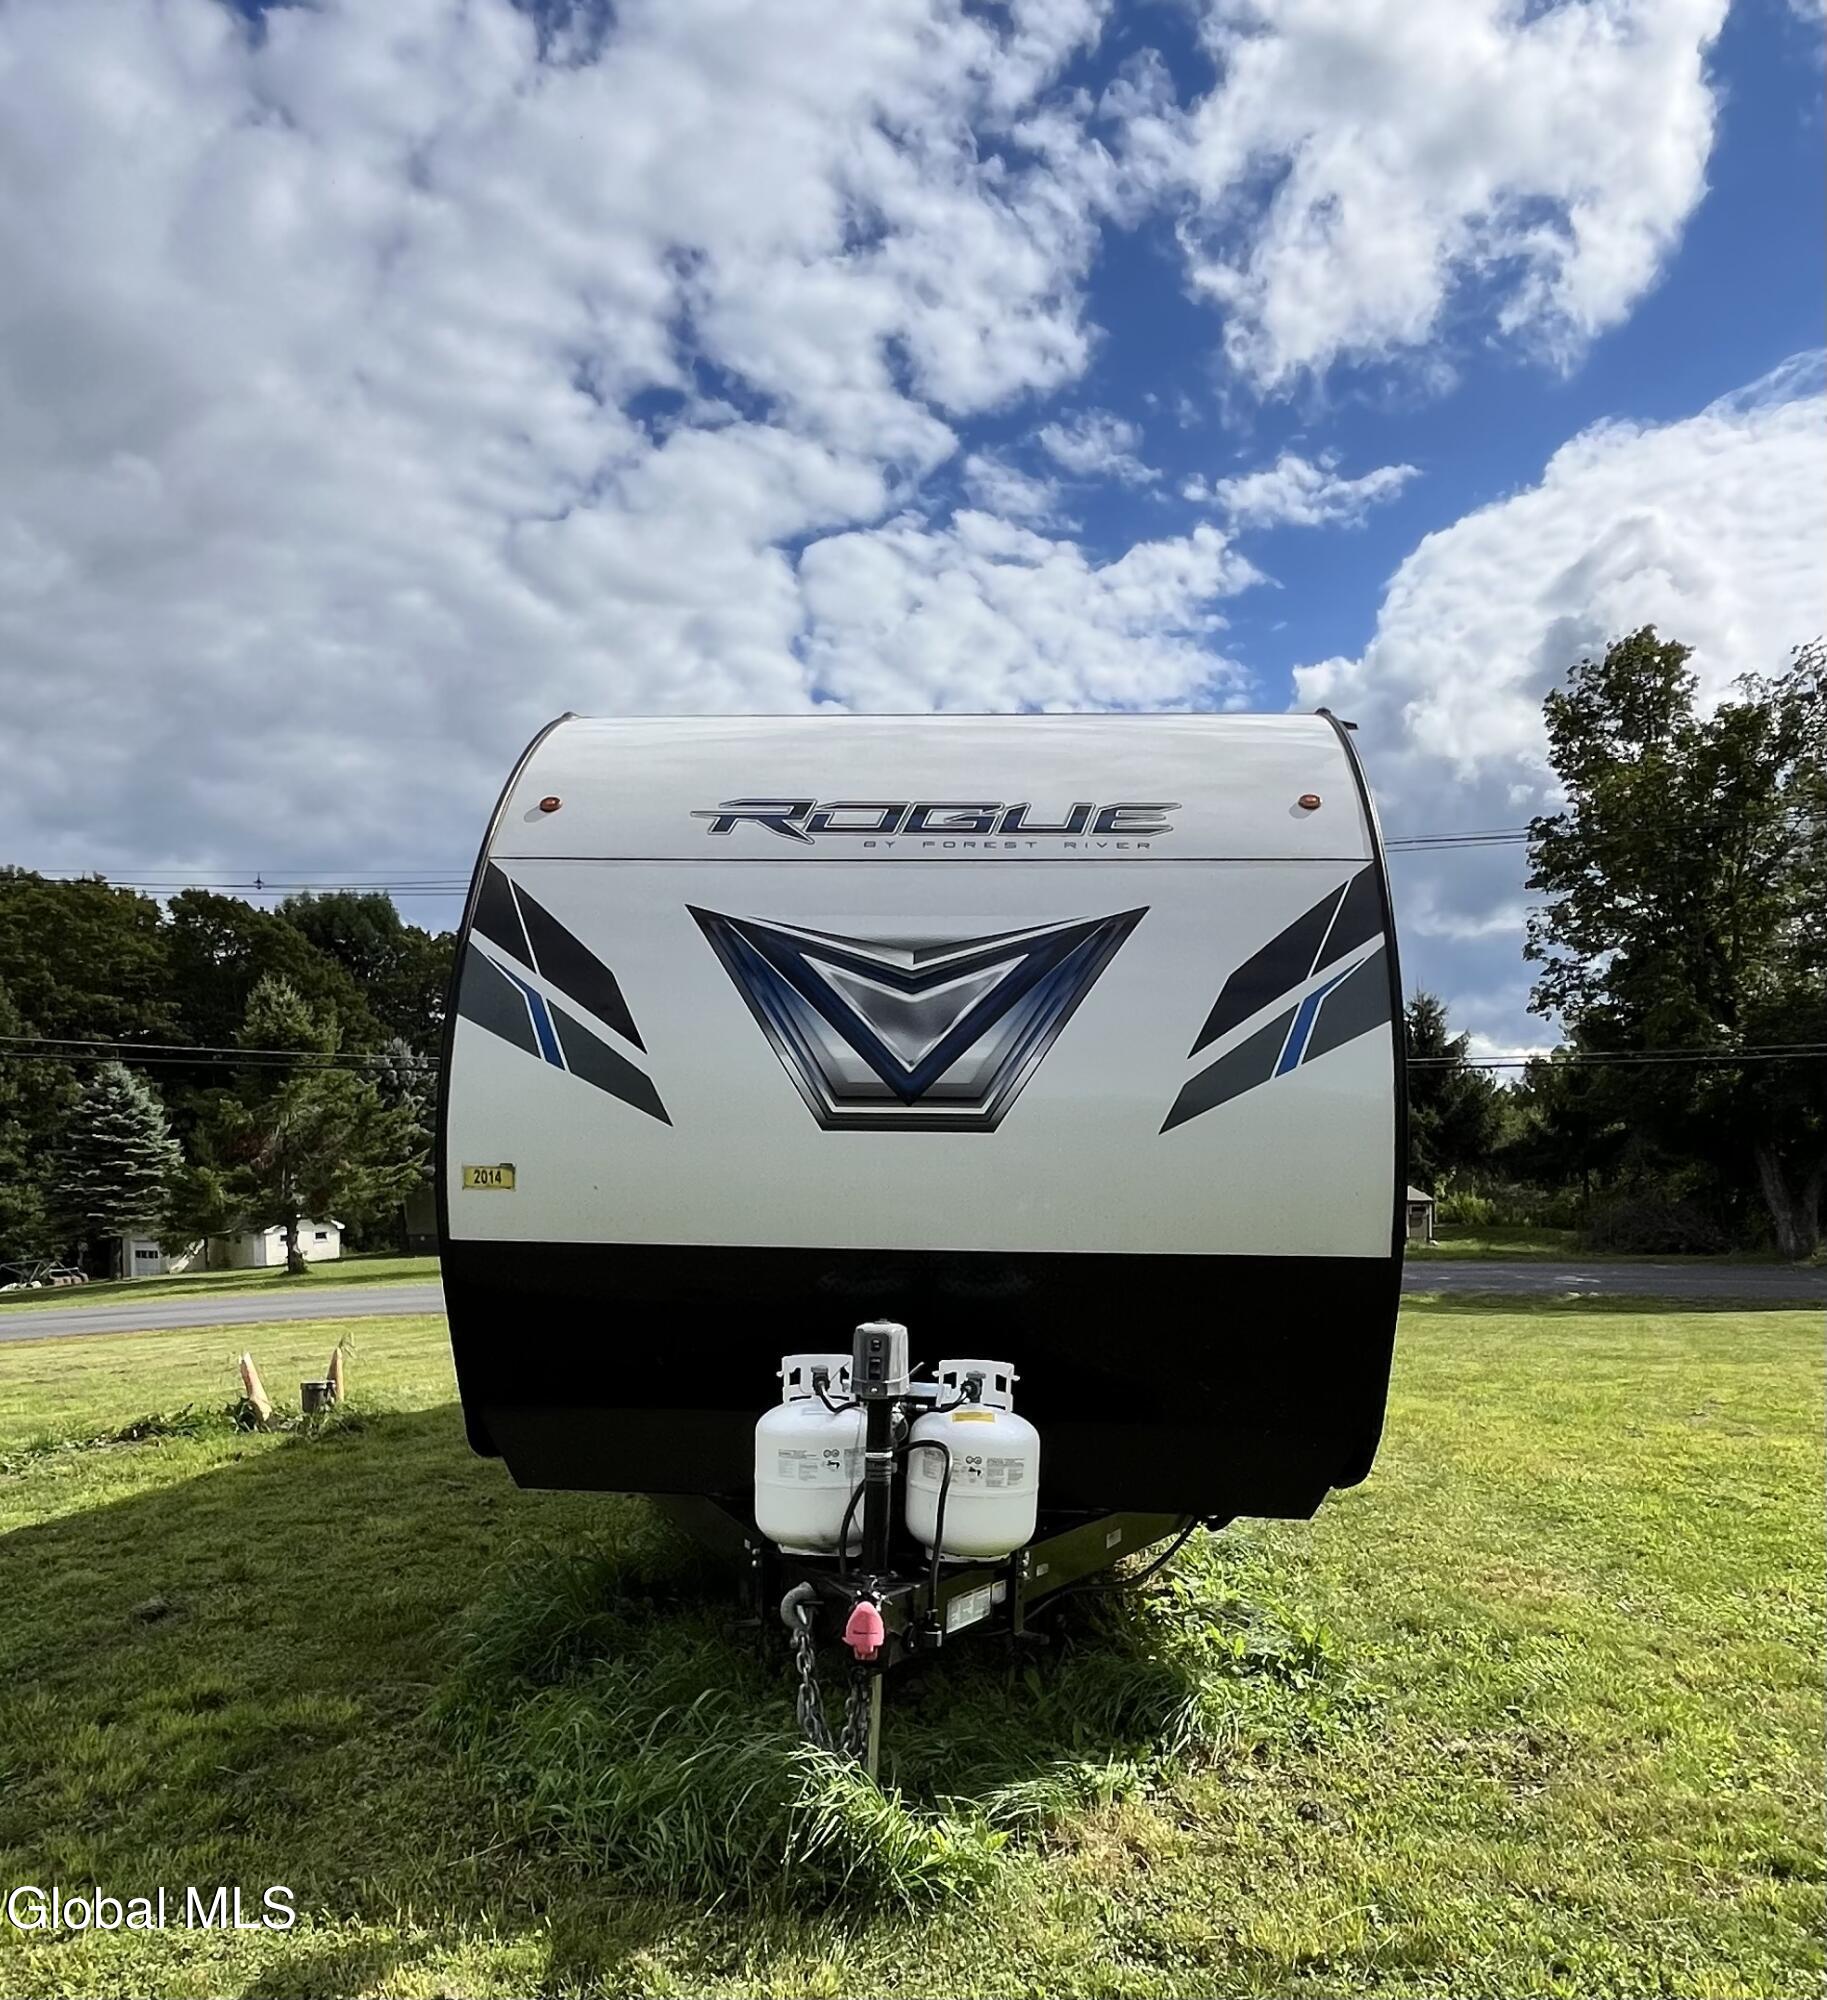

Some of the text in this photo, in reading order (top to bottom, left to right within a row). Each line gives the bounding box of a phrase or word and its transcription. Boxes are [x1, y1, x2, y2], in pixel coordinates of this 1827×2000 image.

[690, 798, 1182, 845] ROGUE
[863, 841, 1151, 850] BY FOREST RIVER
[473, 1169, 502, 1185] 2014
